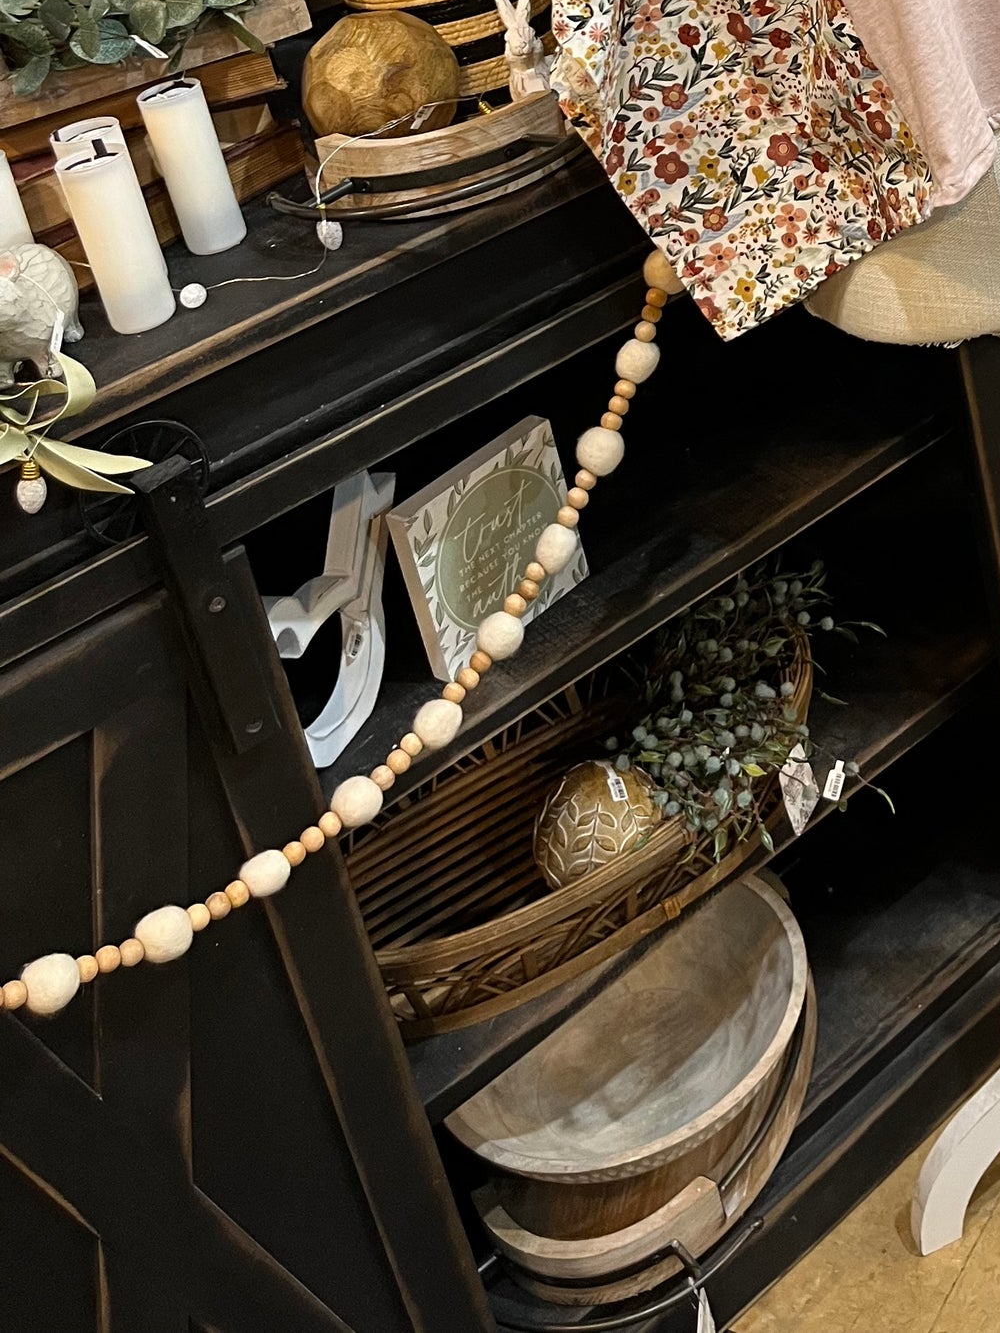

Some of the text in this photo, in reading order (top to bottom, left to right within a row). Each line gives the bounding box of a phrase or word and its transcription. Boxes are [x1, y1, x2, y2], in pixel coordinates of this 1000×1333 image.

[454, 478, 532, 563] trust
[458, 511, 543, 578] THE NEXT CHAPTER
[459, 559, 499, 593] BECAUSE
[502, 542, 521, 559] YOU
[466, 586, 483, 603] THE
[473, 552, 527, 617] auth
